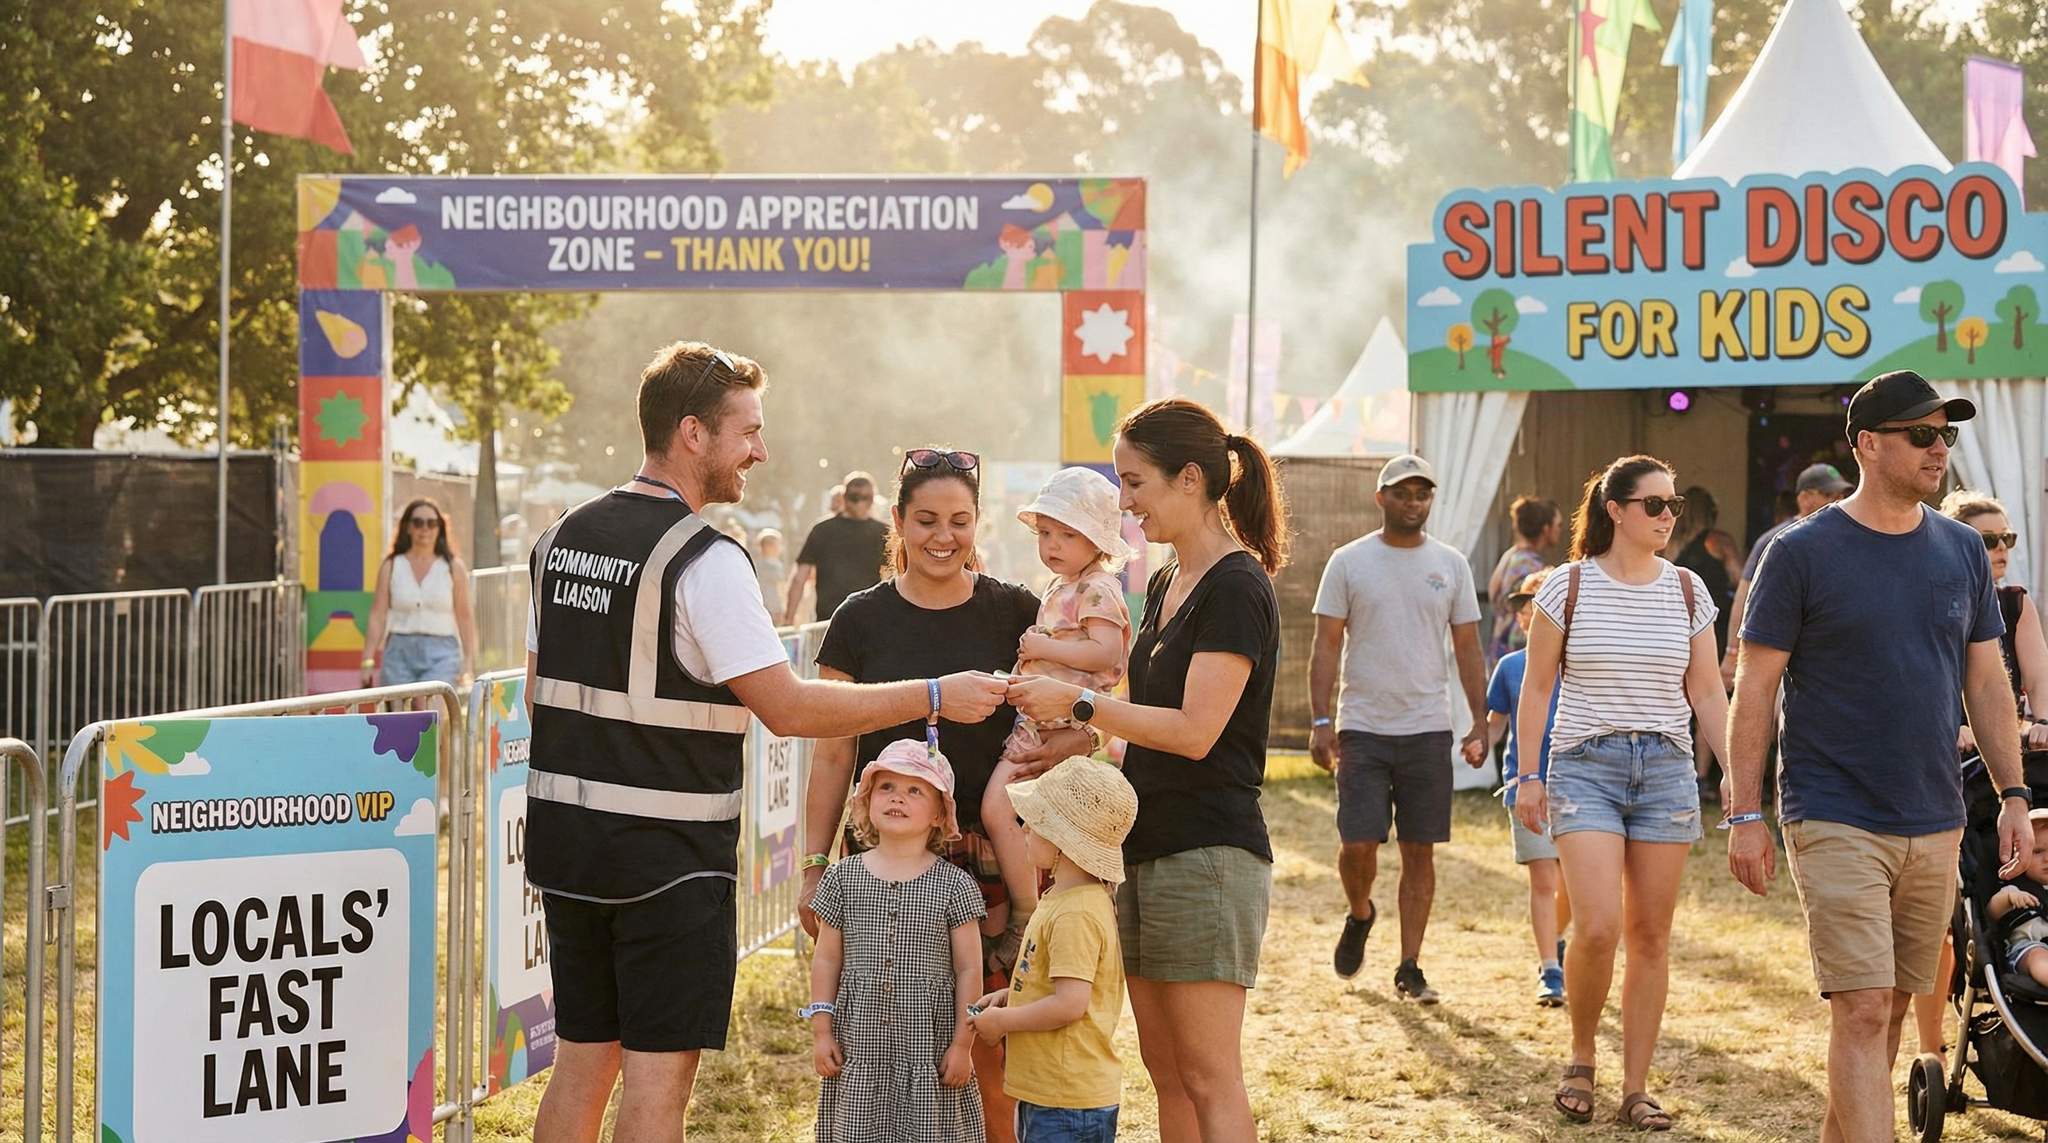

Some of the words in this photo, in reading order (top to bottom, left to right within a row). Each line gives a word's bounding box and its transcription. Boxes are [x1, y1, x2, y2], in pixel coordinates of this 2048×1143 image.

[441, 195, 728, 230] NEIGHBOURHOOD
[736, 195, 979, 230] APPRECIATION
[1442, 190, 1720, 279] SILENT
[1745, 175, 2008, 268] DISCO
[548, 237, 635, 271] ZONE
[671, 237, 785, 271] THANK
[792, 237, 870, 272] YOU!
[1567, 300, 1678, 360] FOR
[1699, 284, 1872, 361] KIDS
[547, 547, 640, 586] COMMUNITY
[553, 579, 612, 614] LIAISON
[151, 794, 352, 833] NEIGHBOURHOOD
[355, 792, 395, 821] VIP
[768, 776, 789, 812] LANE
[524, 920, 550, 970] LA
[209, 966, 343, 1041] FAST
[203, 1040, 347, 1119] LANE
